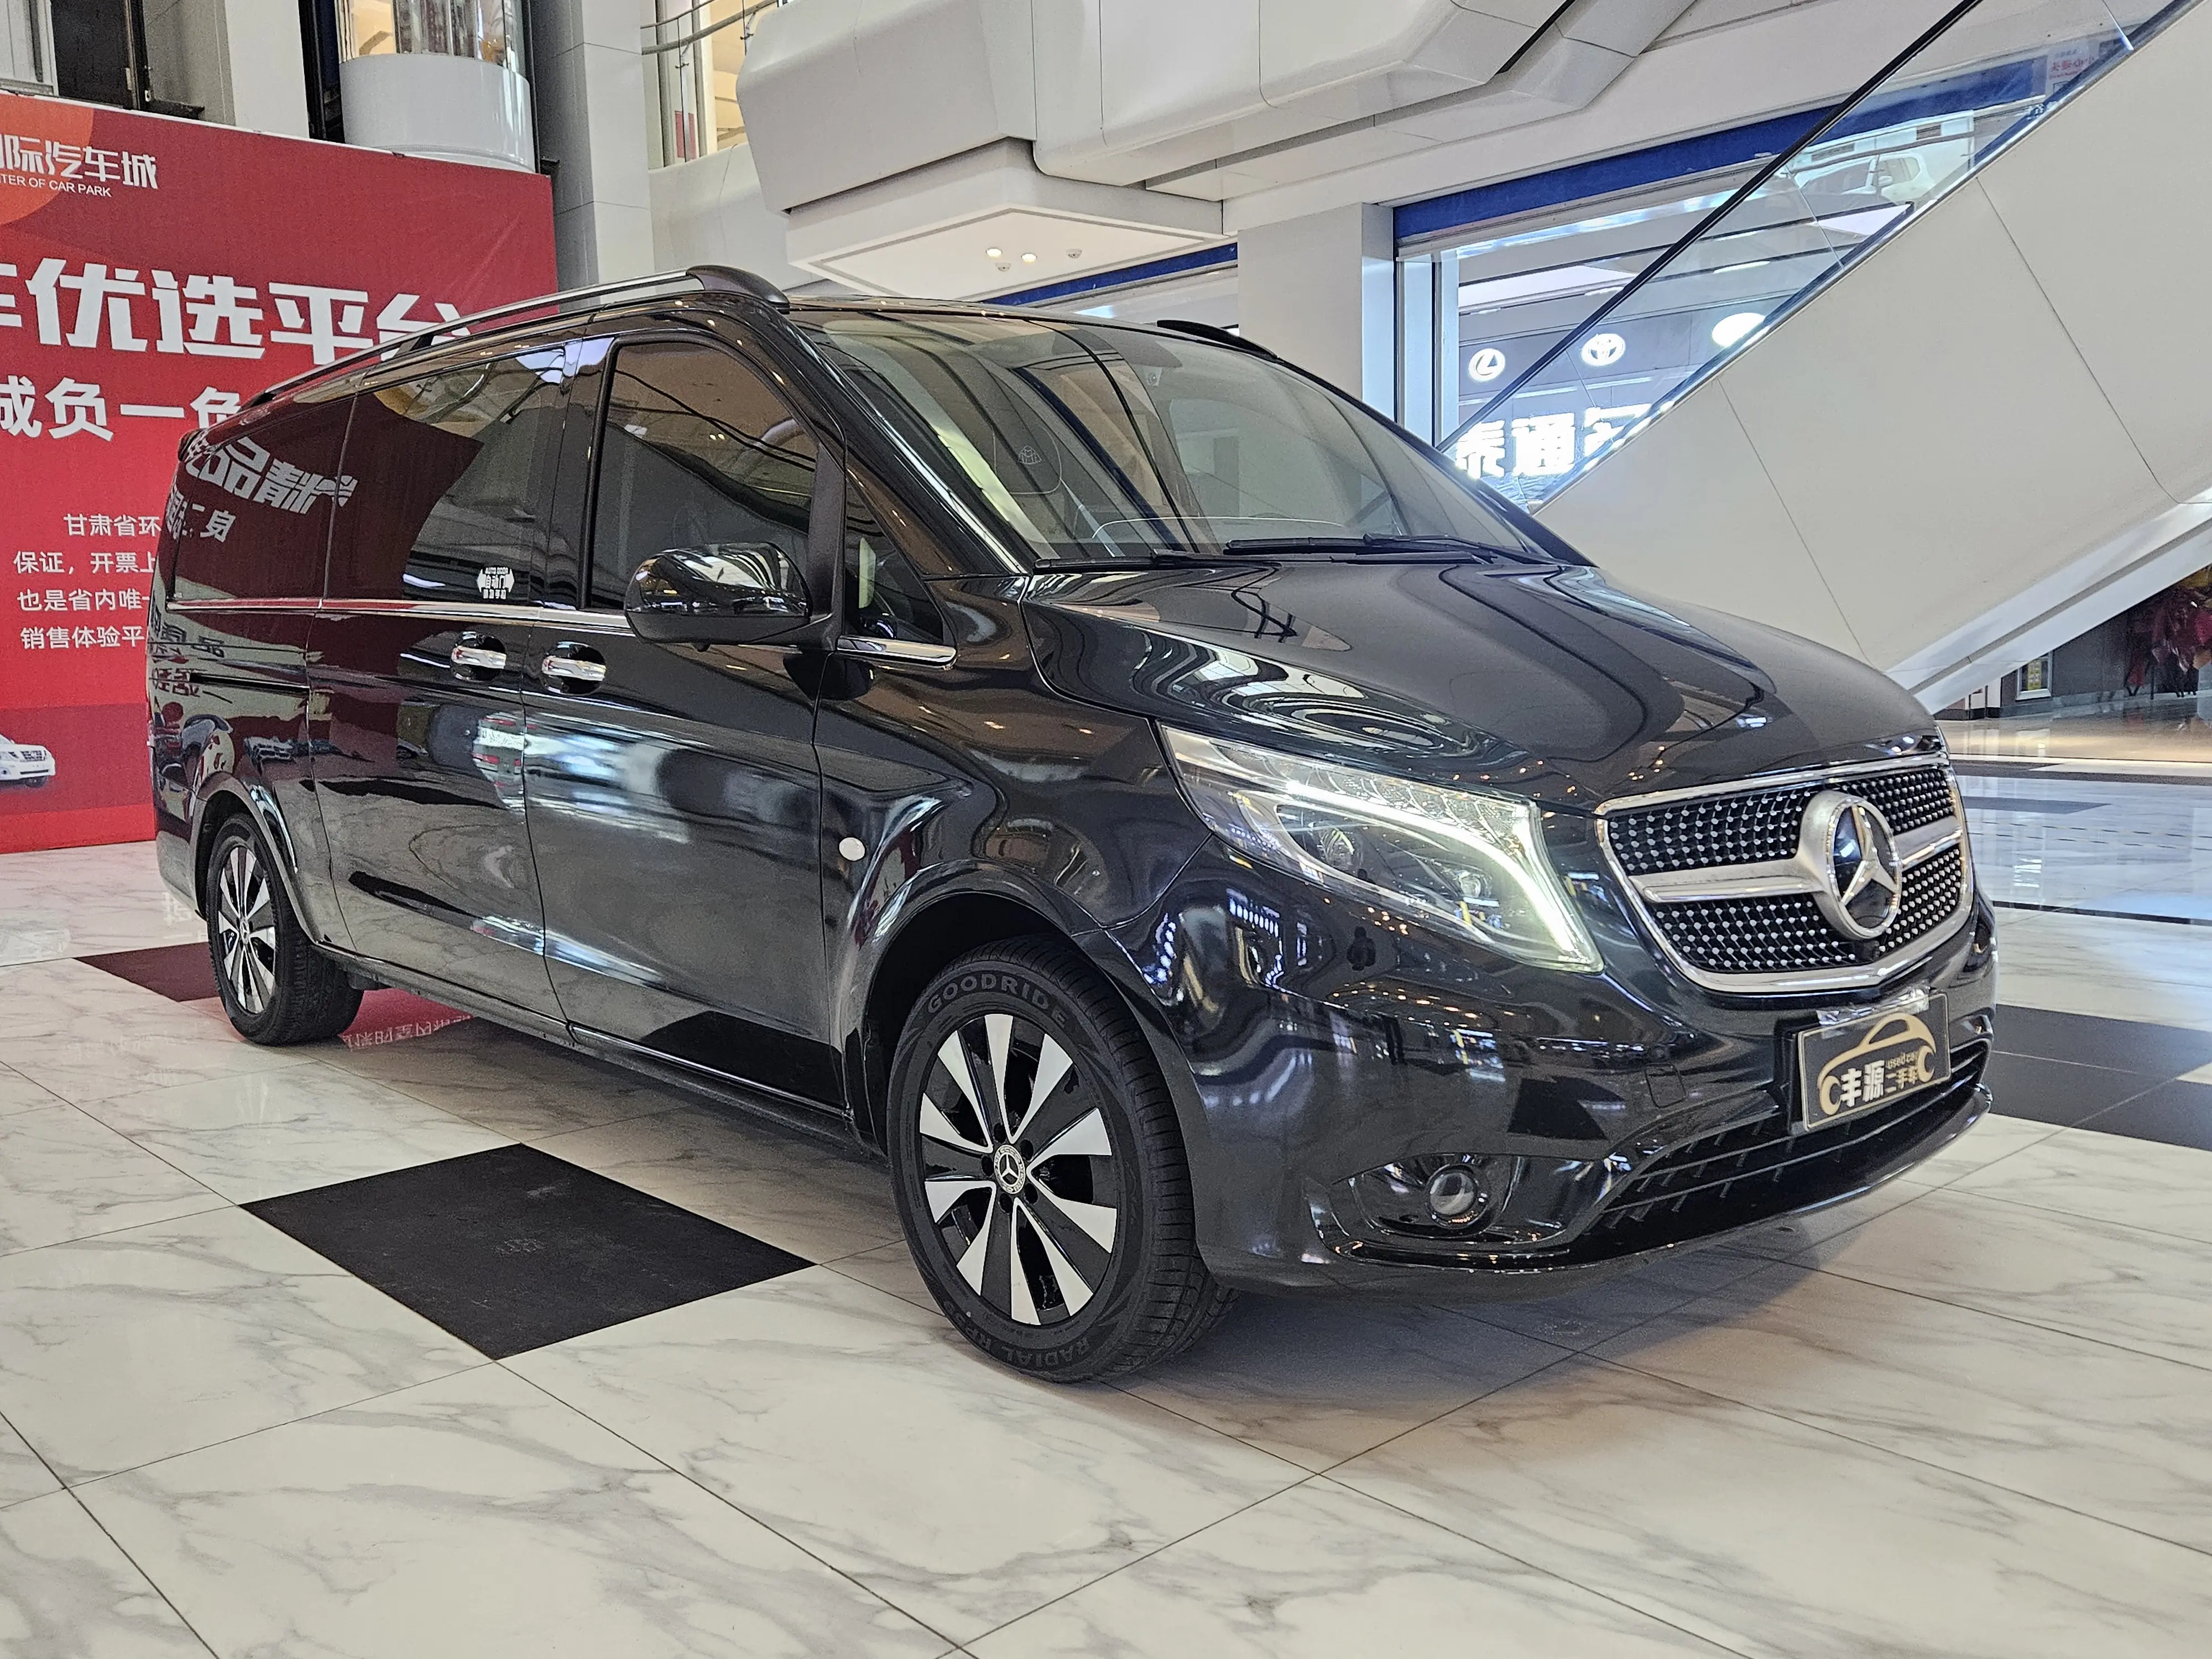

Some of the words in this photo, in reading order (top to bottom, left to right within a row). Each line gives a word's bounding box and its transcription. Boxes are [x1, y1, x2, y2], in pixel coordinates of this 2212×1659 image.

[0, 133, 158, 190] 际汽车城
[0, 173, 27, 187] TER
[28, 177, 46, 189] OF
[49, 180, 75, 192] CAR
[77, 184, 112, 197] PARK
[63, 513, 162, 536] 甘肃省环
[20, 625, 145, 649] 销售体验平
[927, 973, 1068, 1029] GOODRIDE
[1840, 1060, 1885, 1107] 丰源
